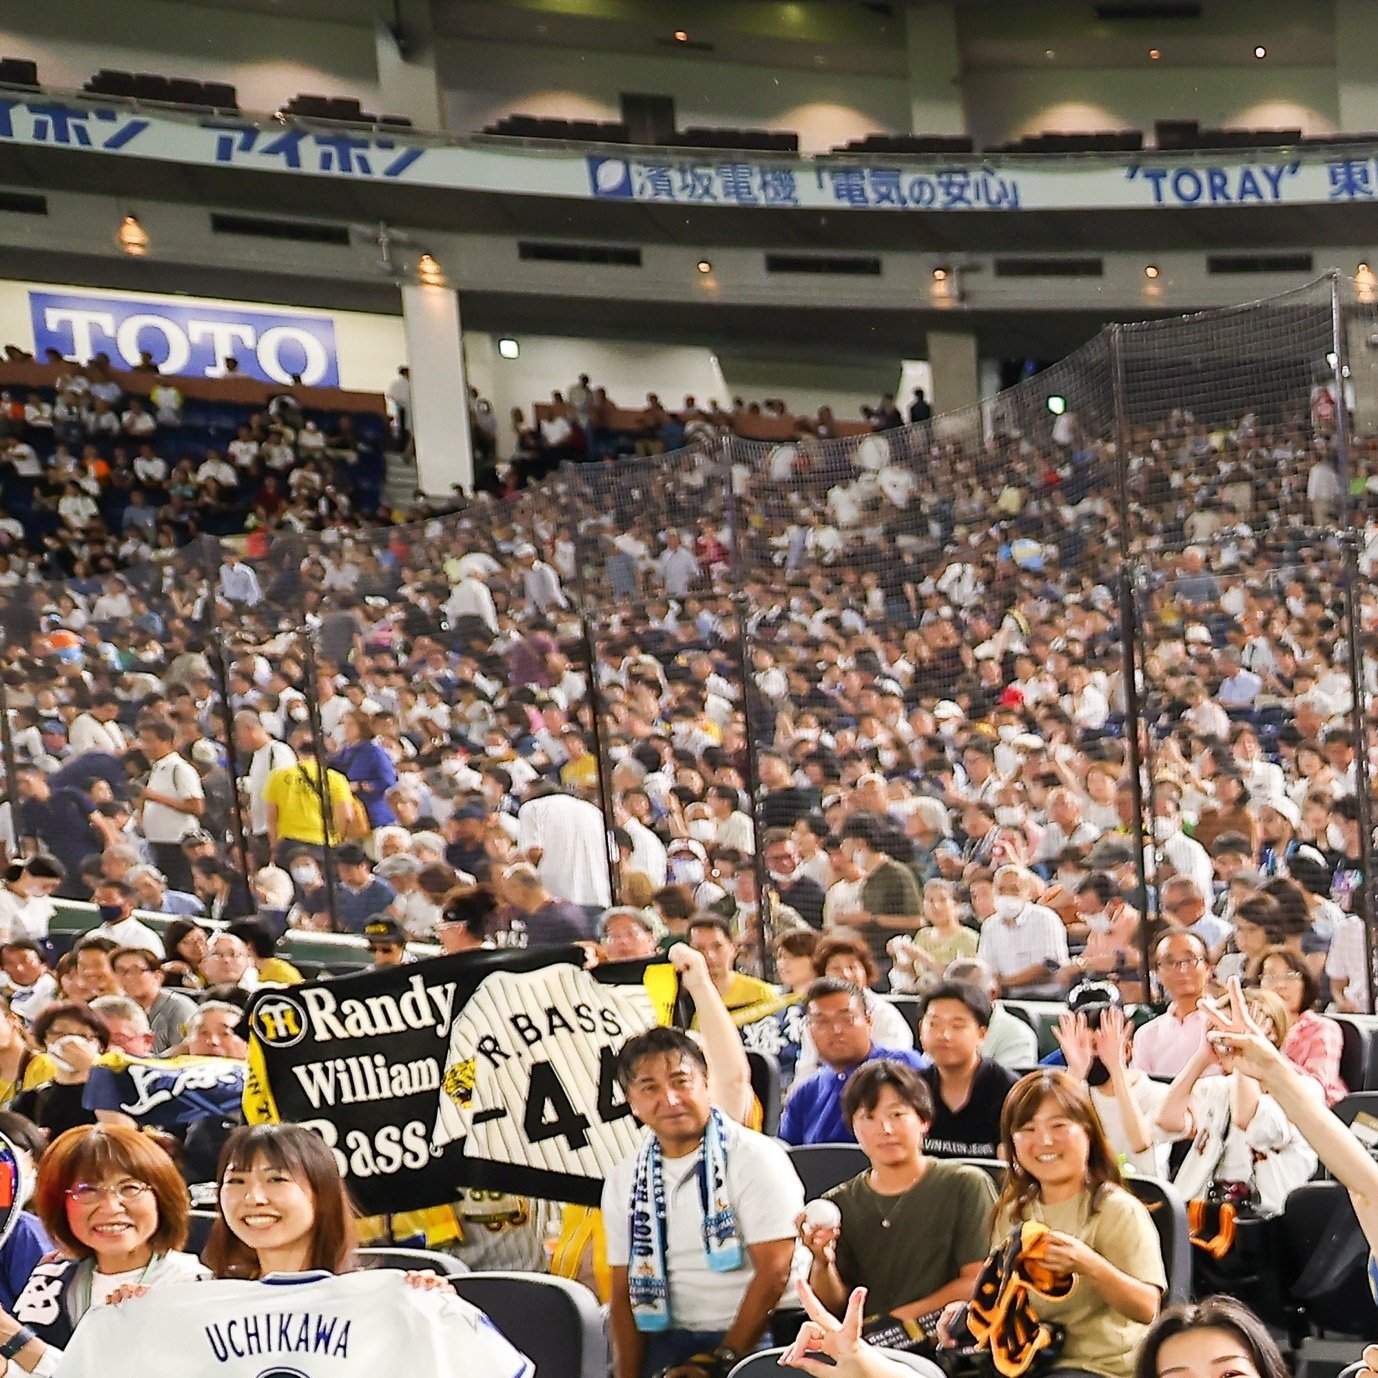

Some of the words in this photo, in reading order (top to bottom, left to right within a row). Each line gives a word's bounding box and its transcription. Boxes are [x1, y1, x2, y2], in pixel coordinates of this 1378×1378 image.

[45, 307, 328, 384] TOTO
[300, 974, 458, 1042] Randy
[476, 1003, 623, 1069] R.BASS
[292, 1053, 442, 1109] William
[204, 1312, 351, 1362] UCHIKAWA
